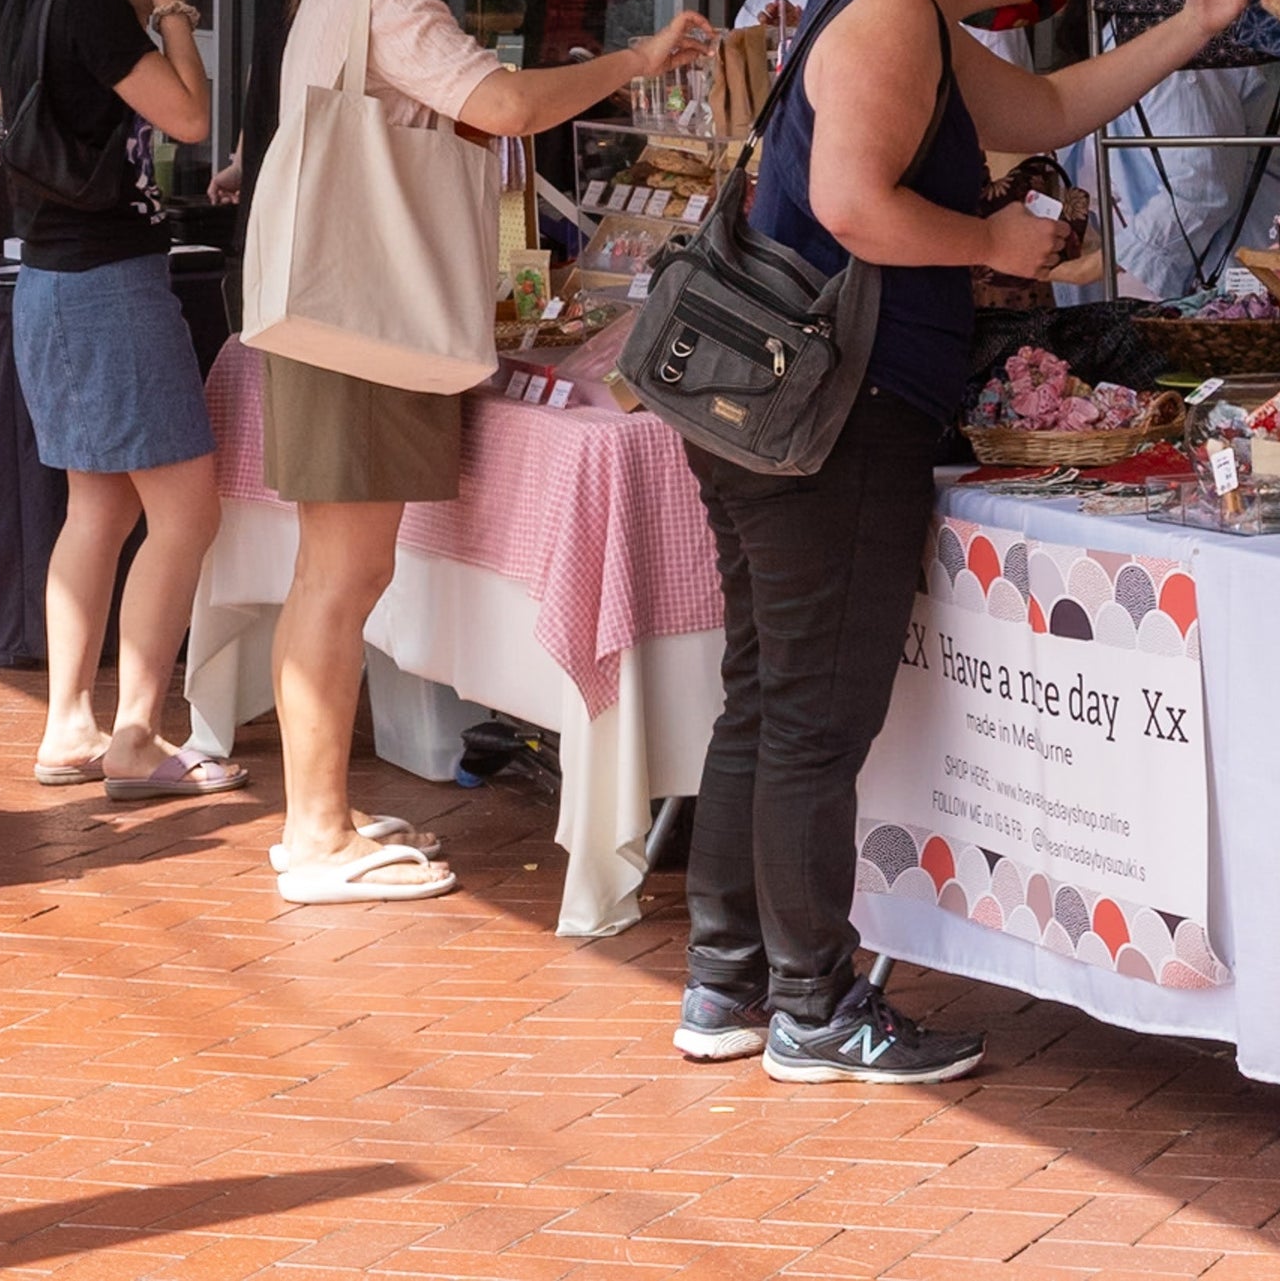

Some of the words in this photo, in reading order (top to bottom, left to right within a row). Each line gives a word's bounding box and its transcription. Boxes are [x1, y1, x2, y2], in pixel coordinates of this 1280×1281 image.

[938, 632, 993, 695] Have
[998, 665, 1013, 700] a
[1068, 672, 1120, 742] day
[1141, 687, 1190, 744] Xx
[965, 712, 997, 740] made
[998, 718, 1012, 744] in
[943, 754, 969, 780] SHOP
[970, 764, 991, 791] HERE
[932, 789, 967, 817] FOLLOW
[969, 801, 982, 824] ME
[983, 810, 994, 828] on
